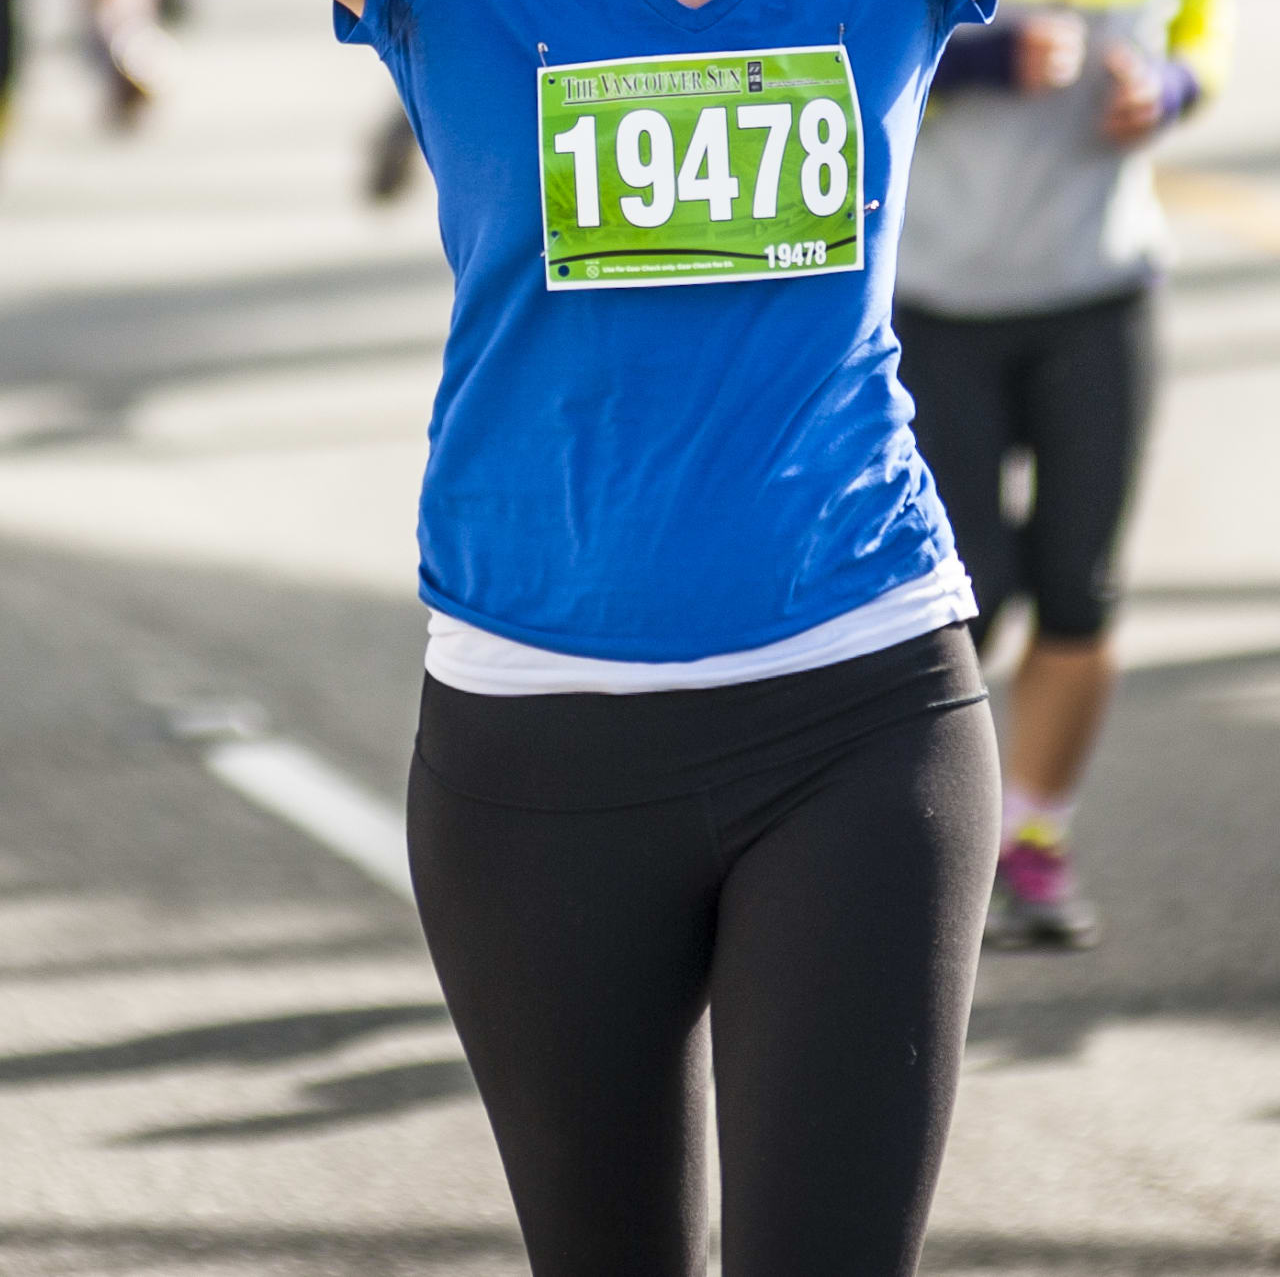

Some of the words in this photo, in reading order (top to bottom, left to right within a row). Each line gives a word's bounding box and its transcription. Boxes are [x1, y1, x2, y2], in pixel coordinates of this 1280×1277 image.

[562, 76, 597, 100] THE
[600, 70, 702, 96] VANCOUVER
[707, 66, 741, 90] SUN
[554, 97, 849, 229] 19478
[764, 240, 827, 269] 19478
